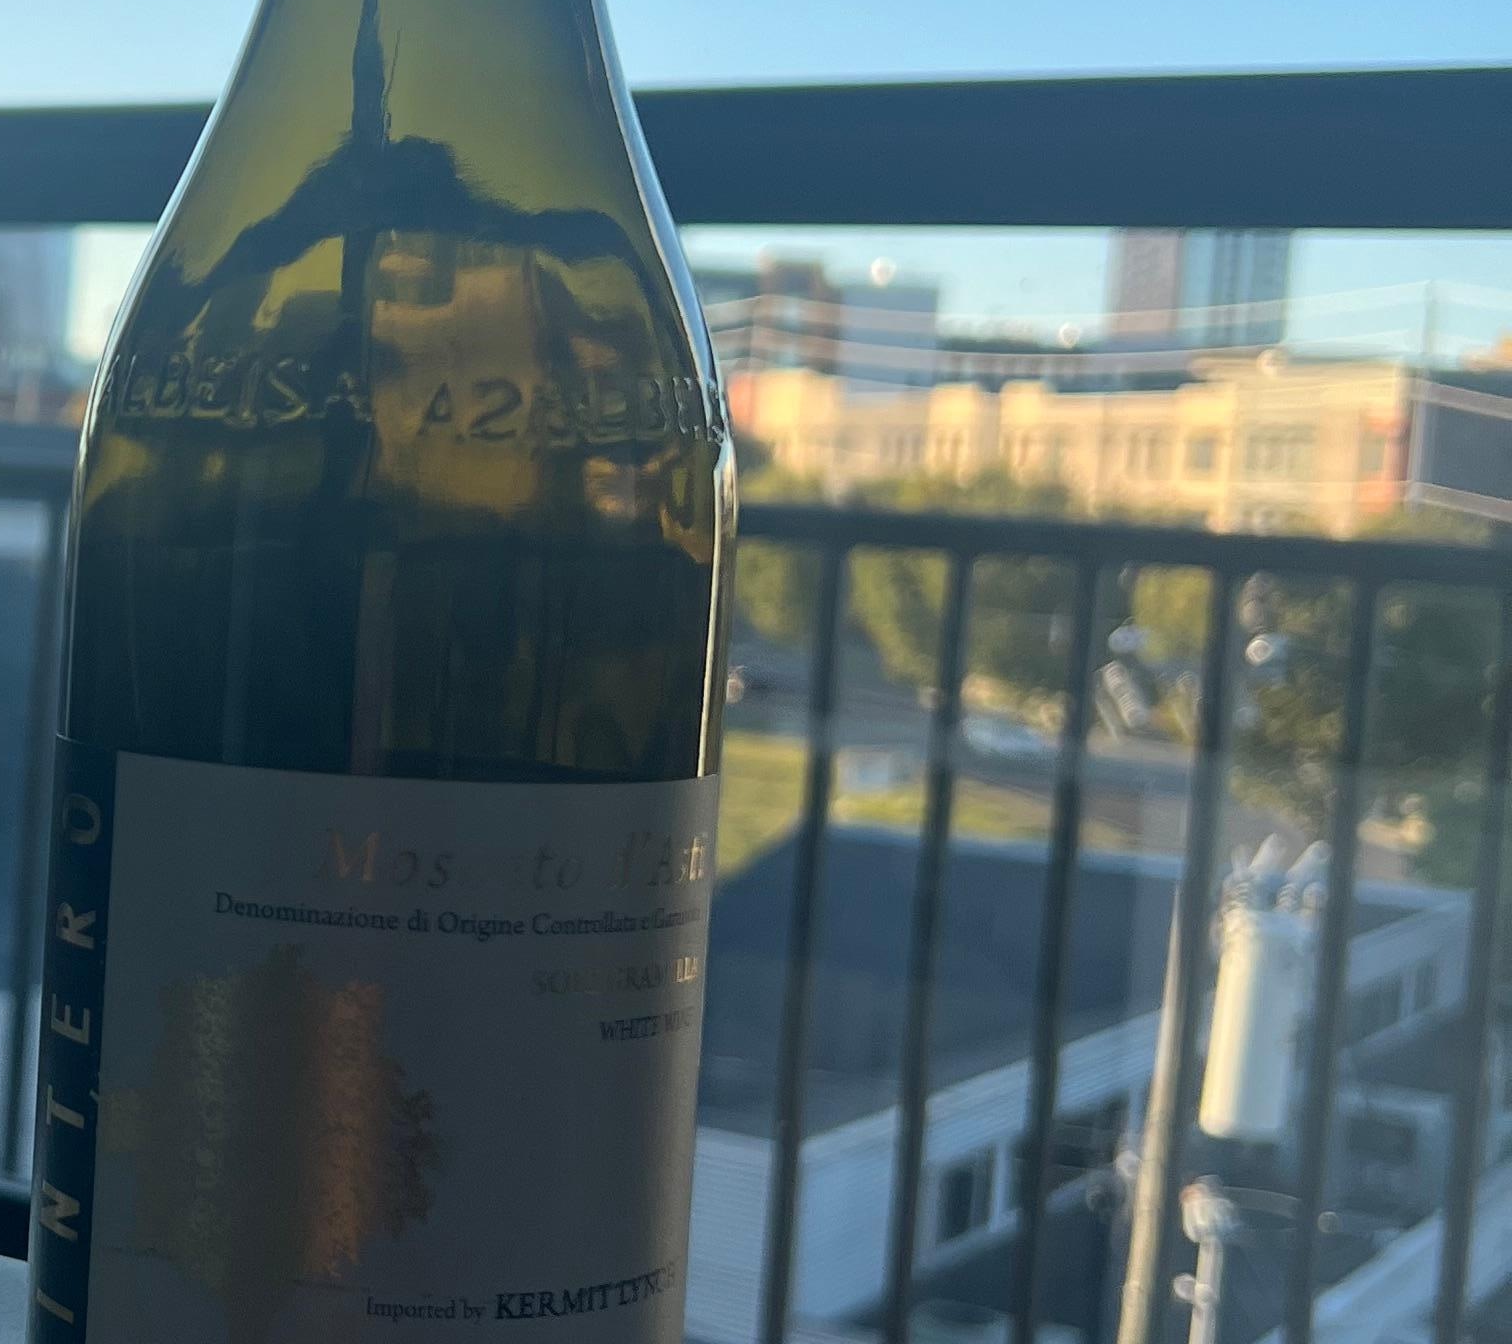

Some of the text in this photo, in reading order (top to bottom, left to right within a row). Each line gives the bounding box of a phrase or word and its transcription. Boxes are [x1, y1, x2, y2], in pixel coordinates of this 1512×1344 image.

[316, 826, 584, 890] Mosto
[214, 891, 398, 931] Denominazione
[407, 907, 431, 934] di
[437, 910, 525, 943] Origine
[366, 1295, 457, 1324] Imported
[463, 1300, 486, 1325] by
[494, 1282, 610, 1321] KERMIT
